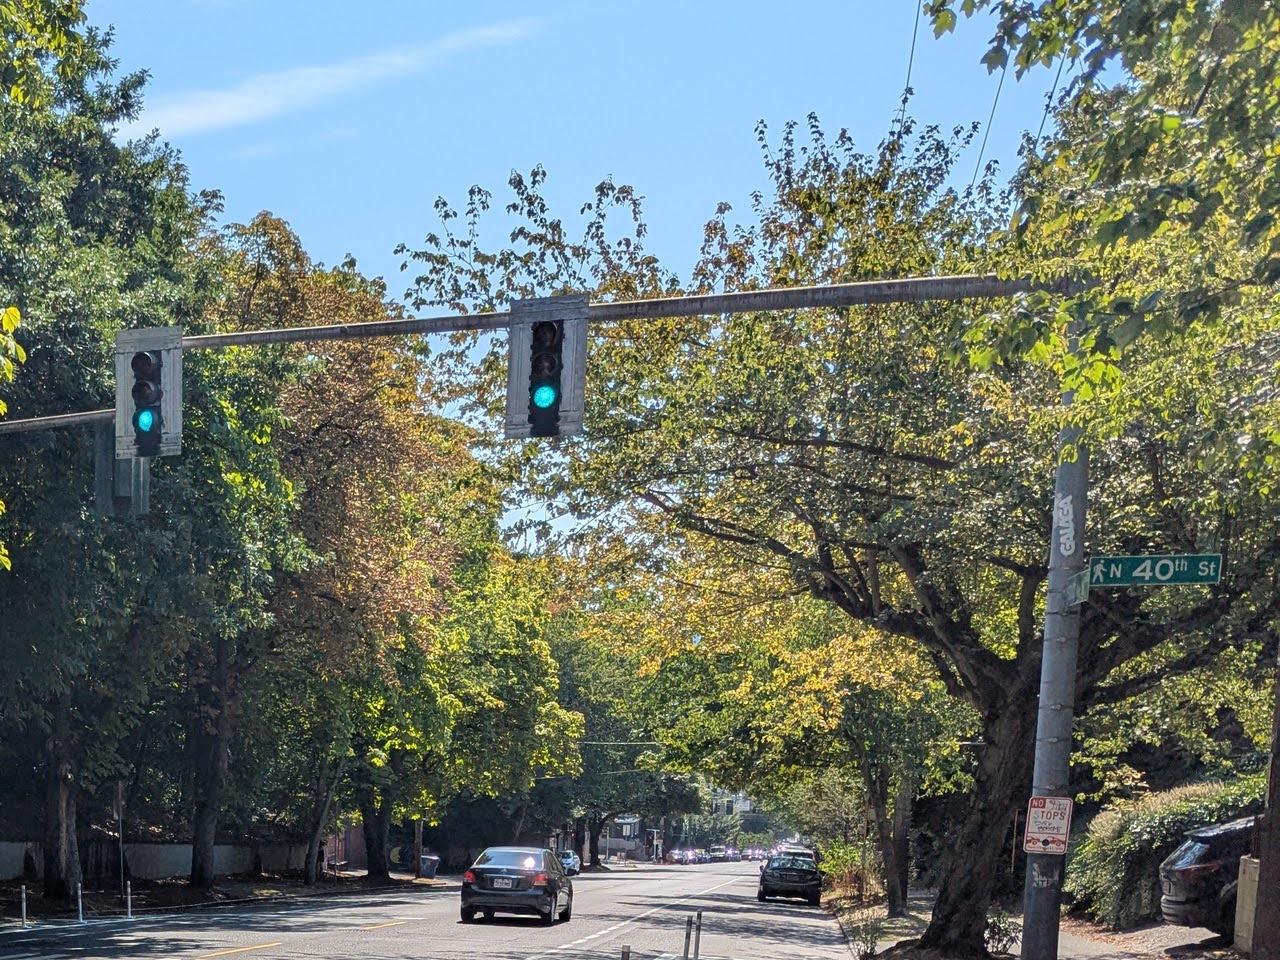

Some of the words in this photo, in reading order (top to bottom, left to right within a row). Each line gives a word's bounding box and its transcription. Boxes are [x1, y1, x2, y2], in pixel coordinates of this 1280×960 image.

[1110, 563, 1122, 578] N
[1132, 559, 1188, 581] 40th
[1198, 561, 1217, 577] St
[1032, 799, 1044, 808] NO
